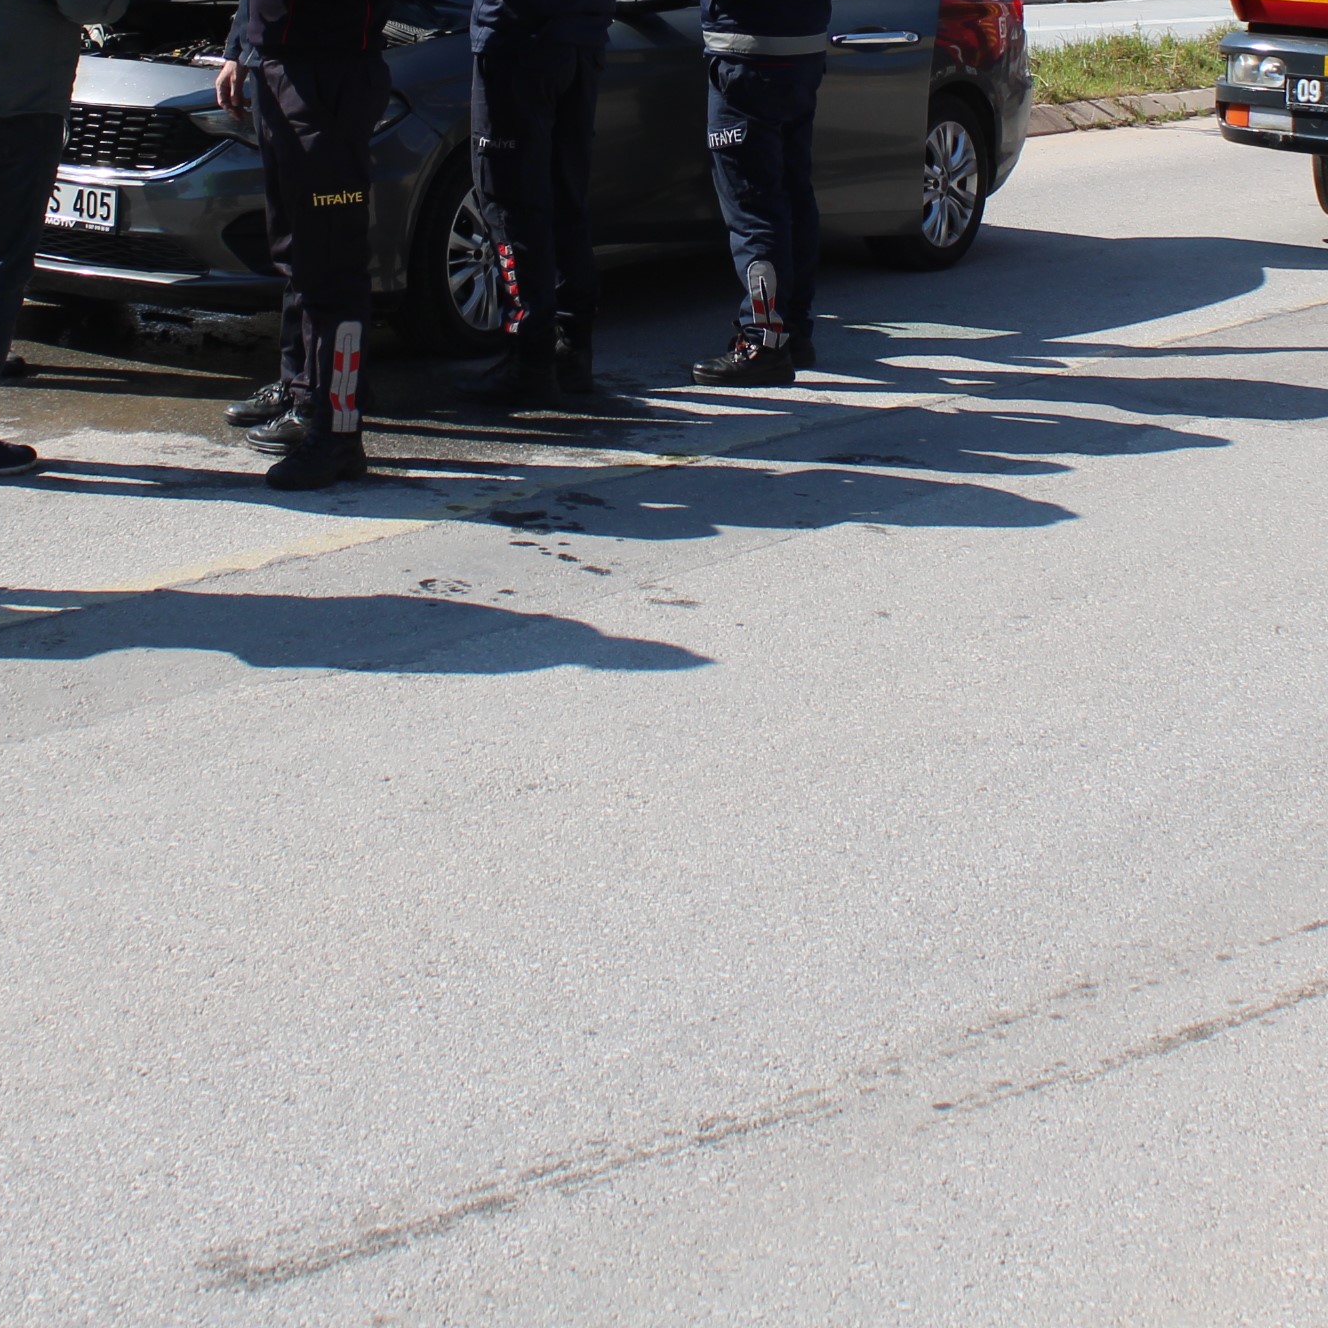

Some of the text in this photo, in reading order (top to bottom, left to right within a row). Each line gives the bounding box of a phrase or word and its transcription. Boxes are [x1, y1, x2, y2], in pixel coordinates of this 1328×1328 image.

[1297, 78, 1322, 103] 09
[73, 188, 112, 222] 405
[312, 190, 364, 207] İTFAİYE
